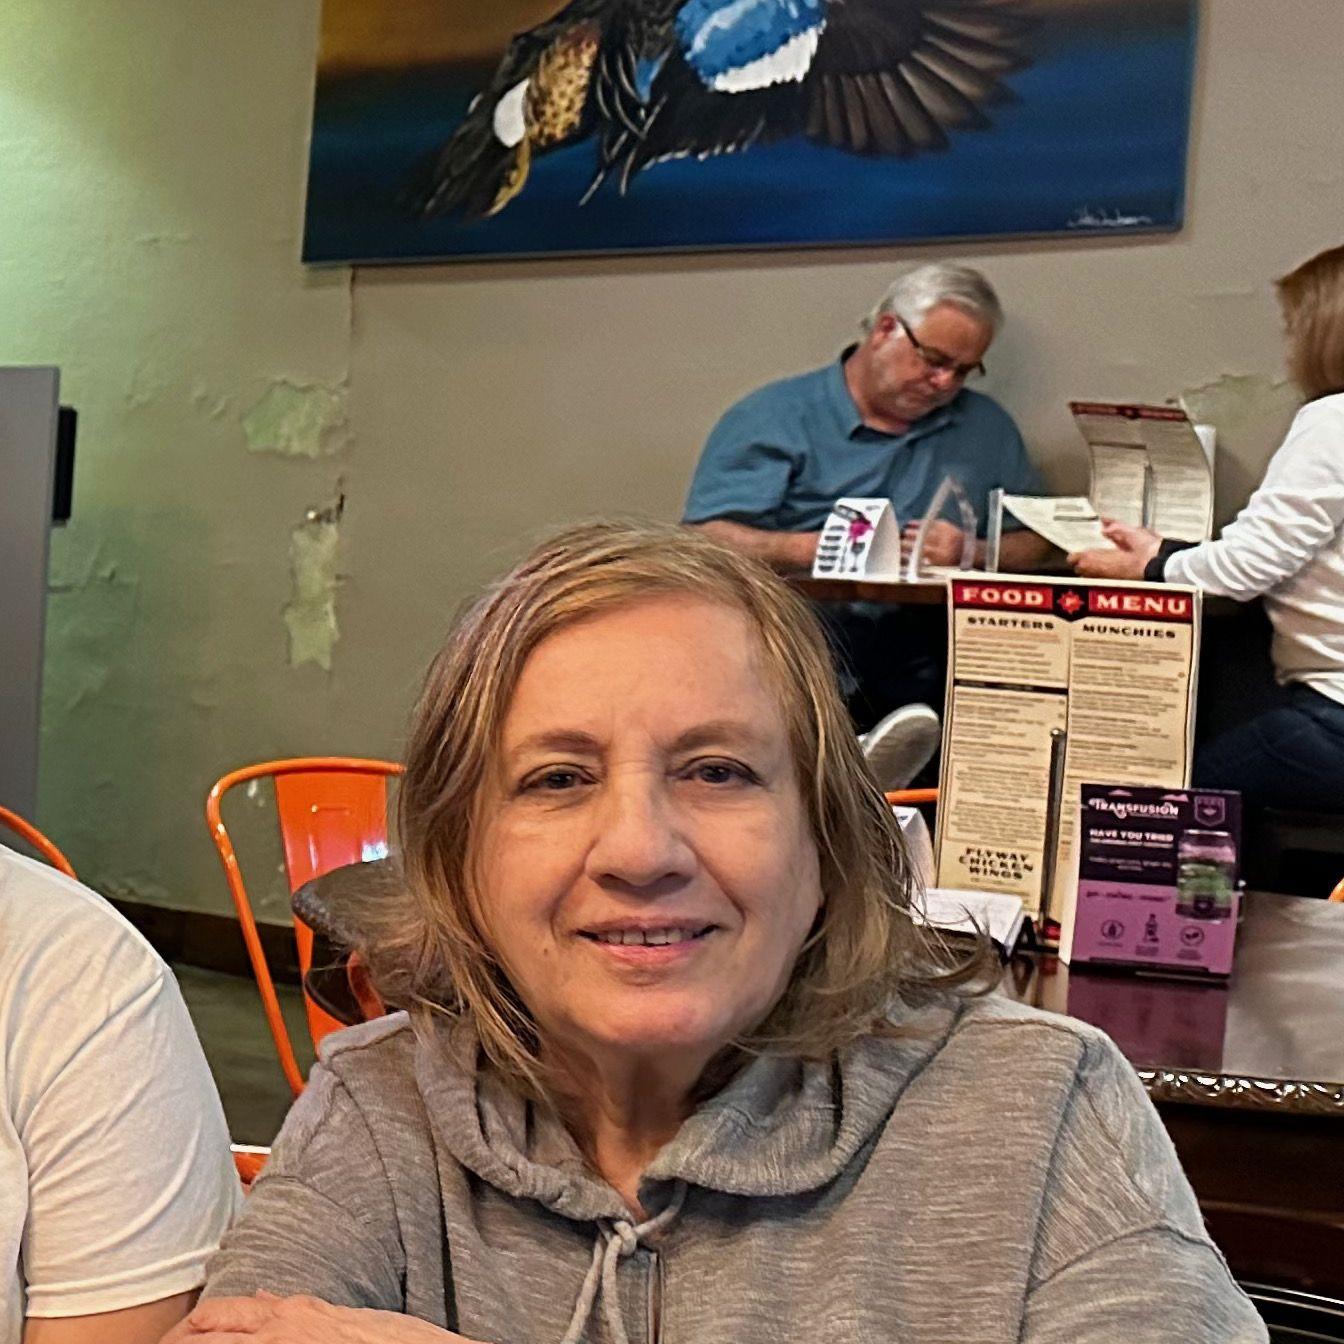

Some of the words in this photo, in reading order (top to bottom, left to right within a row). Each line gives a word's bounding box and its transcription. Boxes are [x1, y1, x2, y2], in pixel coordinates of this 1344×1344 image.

[961, 587, 1045, 606] FOOD
[1096, 594, 1187, 614] MENU
[967, 616, 1054, 630] STARTERS
[1082, 624, 1176, 639] MUNCHIES
[1089, 828, 1117, 838] HAVE
[1120, 832, 1143, 841] YOU
[1145, 832, 1174, 843] TRIED
[965, 847, 1029, 862] FLYWAY
[959, 856, 1034, 873] CHICKEN
[969, 866, 1024, 880] WINGS
